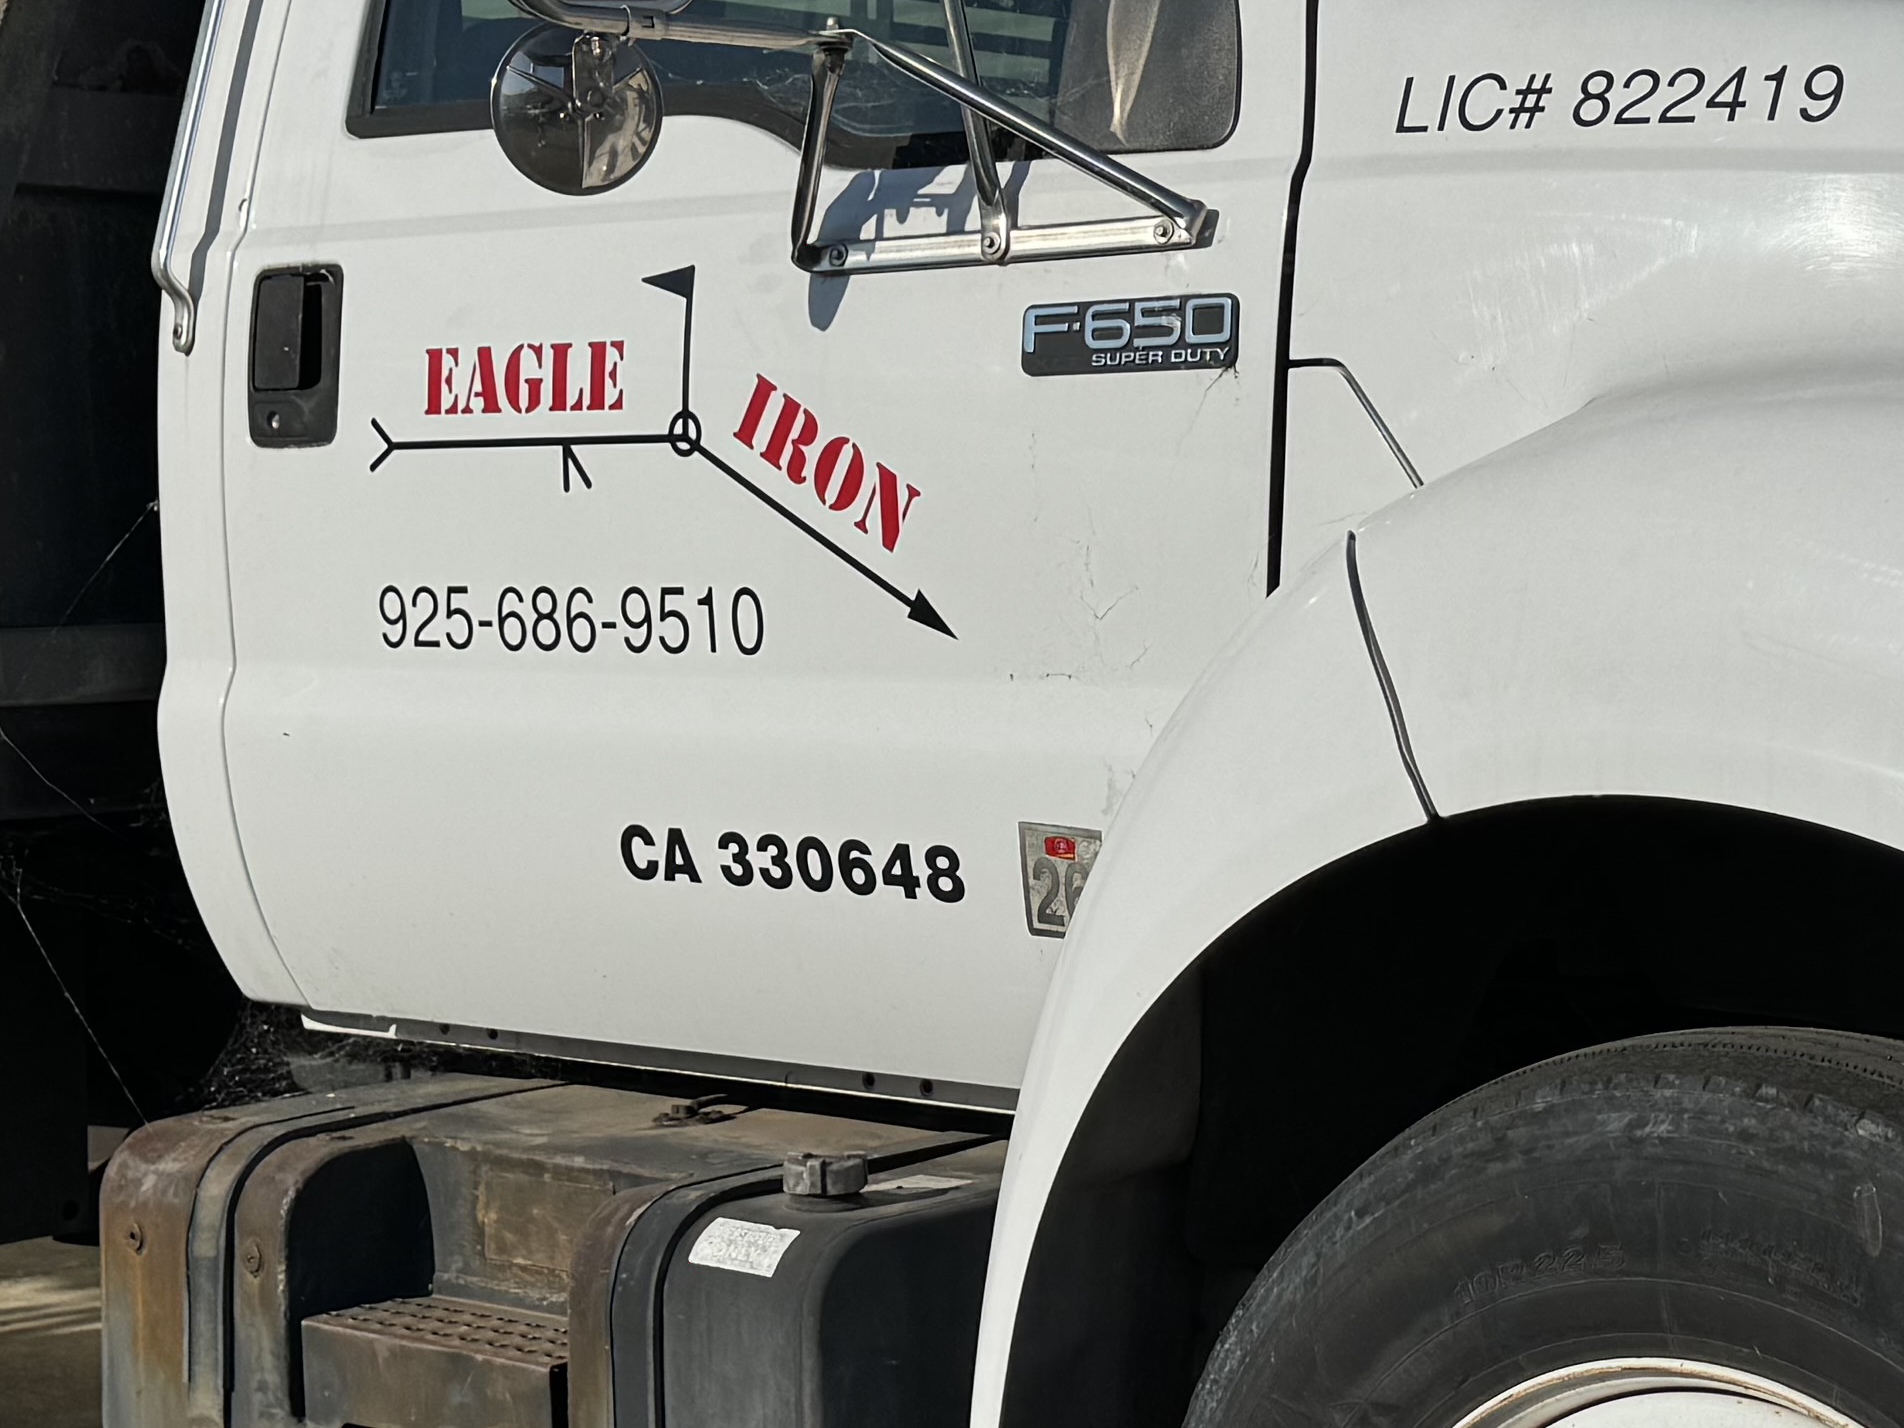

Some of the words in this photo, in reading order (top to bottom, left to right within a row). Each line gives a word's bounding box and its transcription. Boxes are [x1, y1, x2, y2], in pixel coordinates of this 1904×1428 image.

[1395, 72, 1553, 134] LIC#
[1572, 64, 1845, 127] 822419
[423, 340, 624, 416] EAGLE
[1091, 350, 1163, 367] SUPER
[1171, 346, 1230, 363] DUTY
[732, 373, 922, 553] IRON
[378, 584, 765, 656] 925-686-9510
[620, 823, 703, 884] CA
[717, 830, 966, 903] 330648
